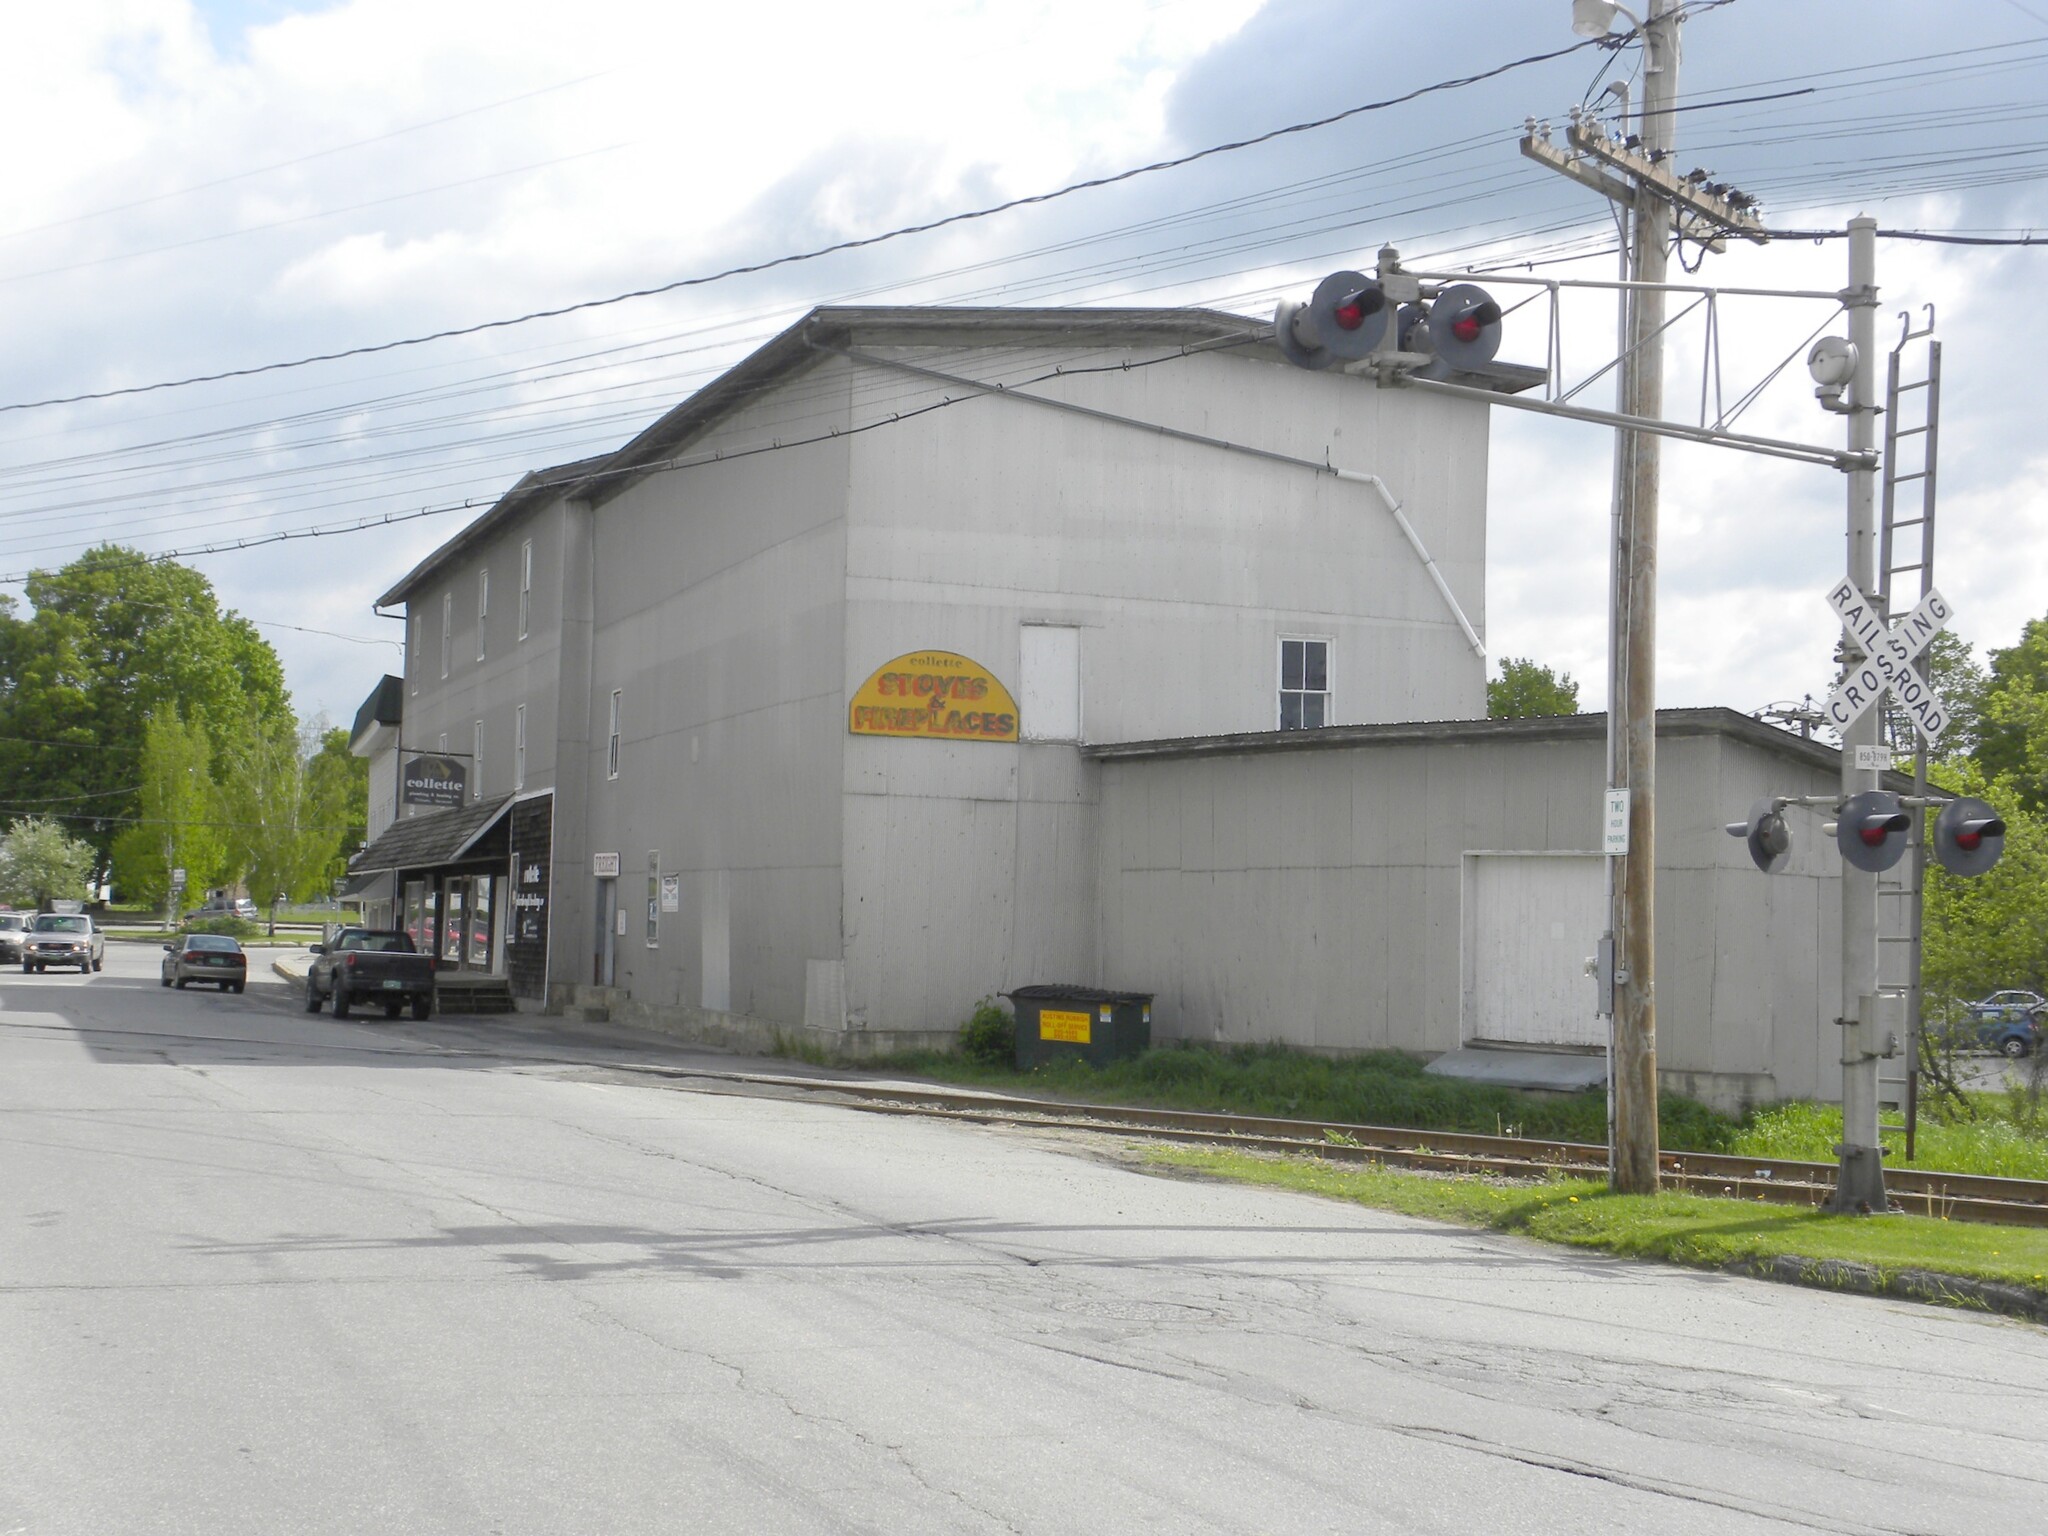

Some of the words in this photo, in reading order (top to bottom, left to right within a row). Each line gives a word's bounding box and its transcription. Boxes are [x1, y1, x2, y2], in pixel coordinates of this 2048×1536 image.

[1833, 584, 1880, 652] RAIL
[909, 656, 963, 668] collette
[1831, 597, 1946, 724] CROSSING
[877, 672, 989, 701] STOVES
[927, 694, 946, 711] &
[1893, 667, 1942, 733] ROAD
[854, 705, 1015, 737] FIREPLACES
[406, 778, 463, 791] collette
[1610, 800, 1624, 813] TWO
[1610, 818, 1623, 828] HOUR
[1607, 834, 1626, 844] PARKING
